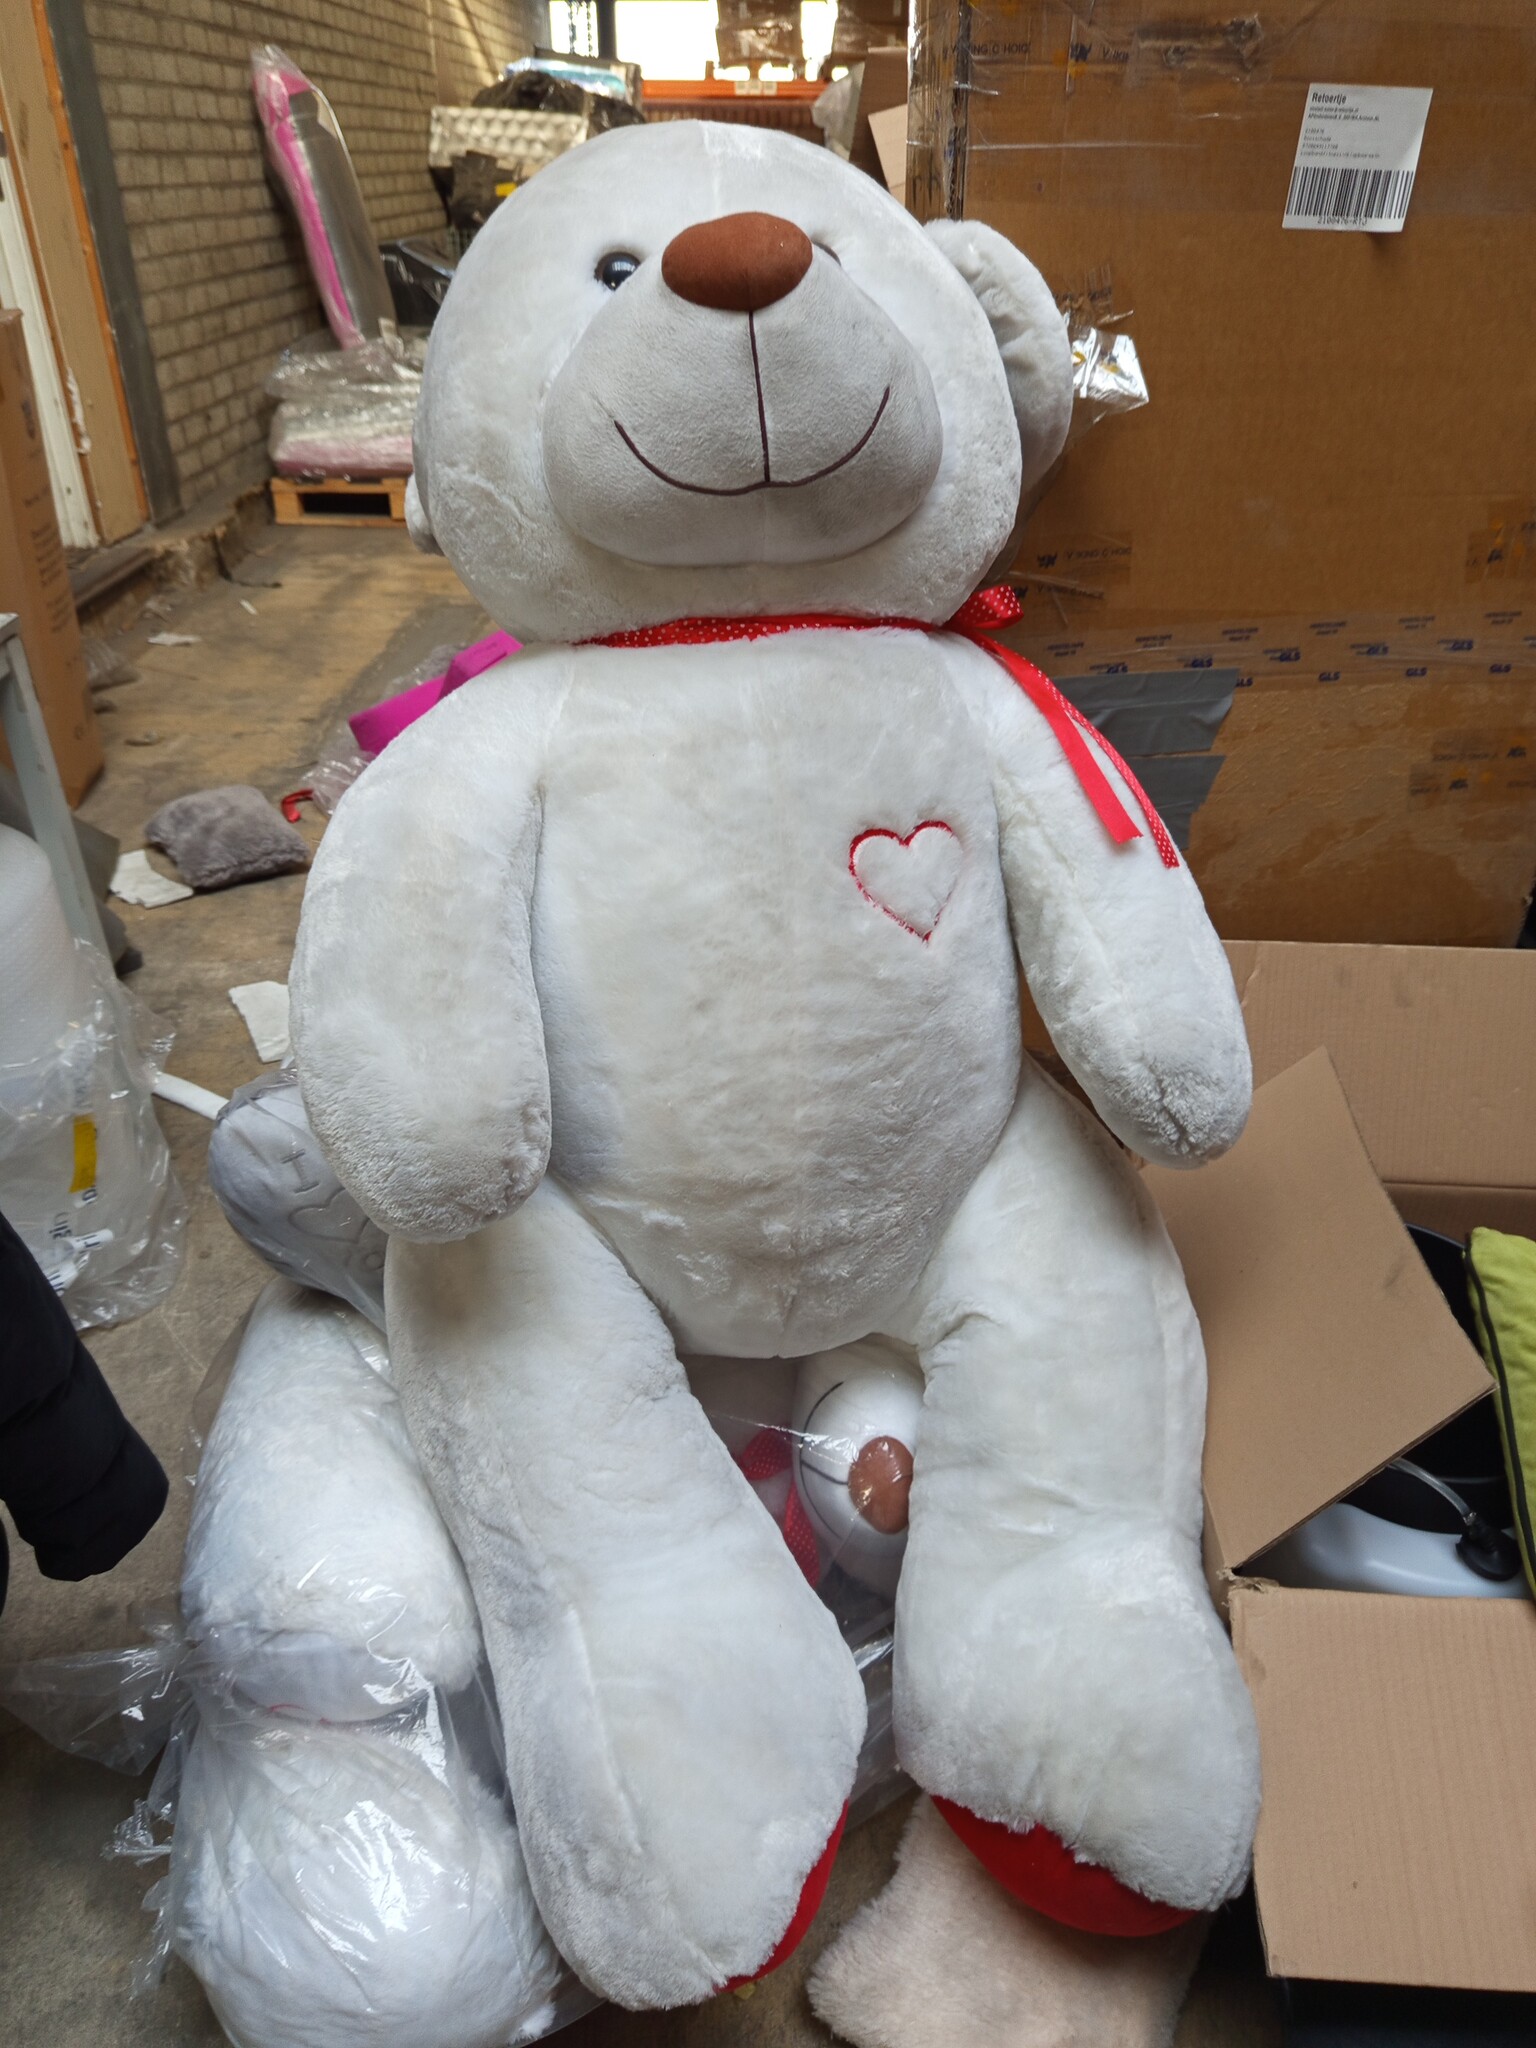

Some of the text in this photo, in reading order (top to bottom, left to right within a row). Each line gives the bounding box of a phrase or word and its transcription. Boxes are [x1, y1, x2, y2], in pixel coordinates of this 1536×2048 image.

[1312, 92, 1347, 105] Retoertje
[1279, 652, 1301, 662] GLS
[1405, 667, 1428, 677] GLS
[1488, 663, 1512, 674] GLS
[1318, 671, 1341, 682] GLS
